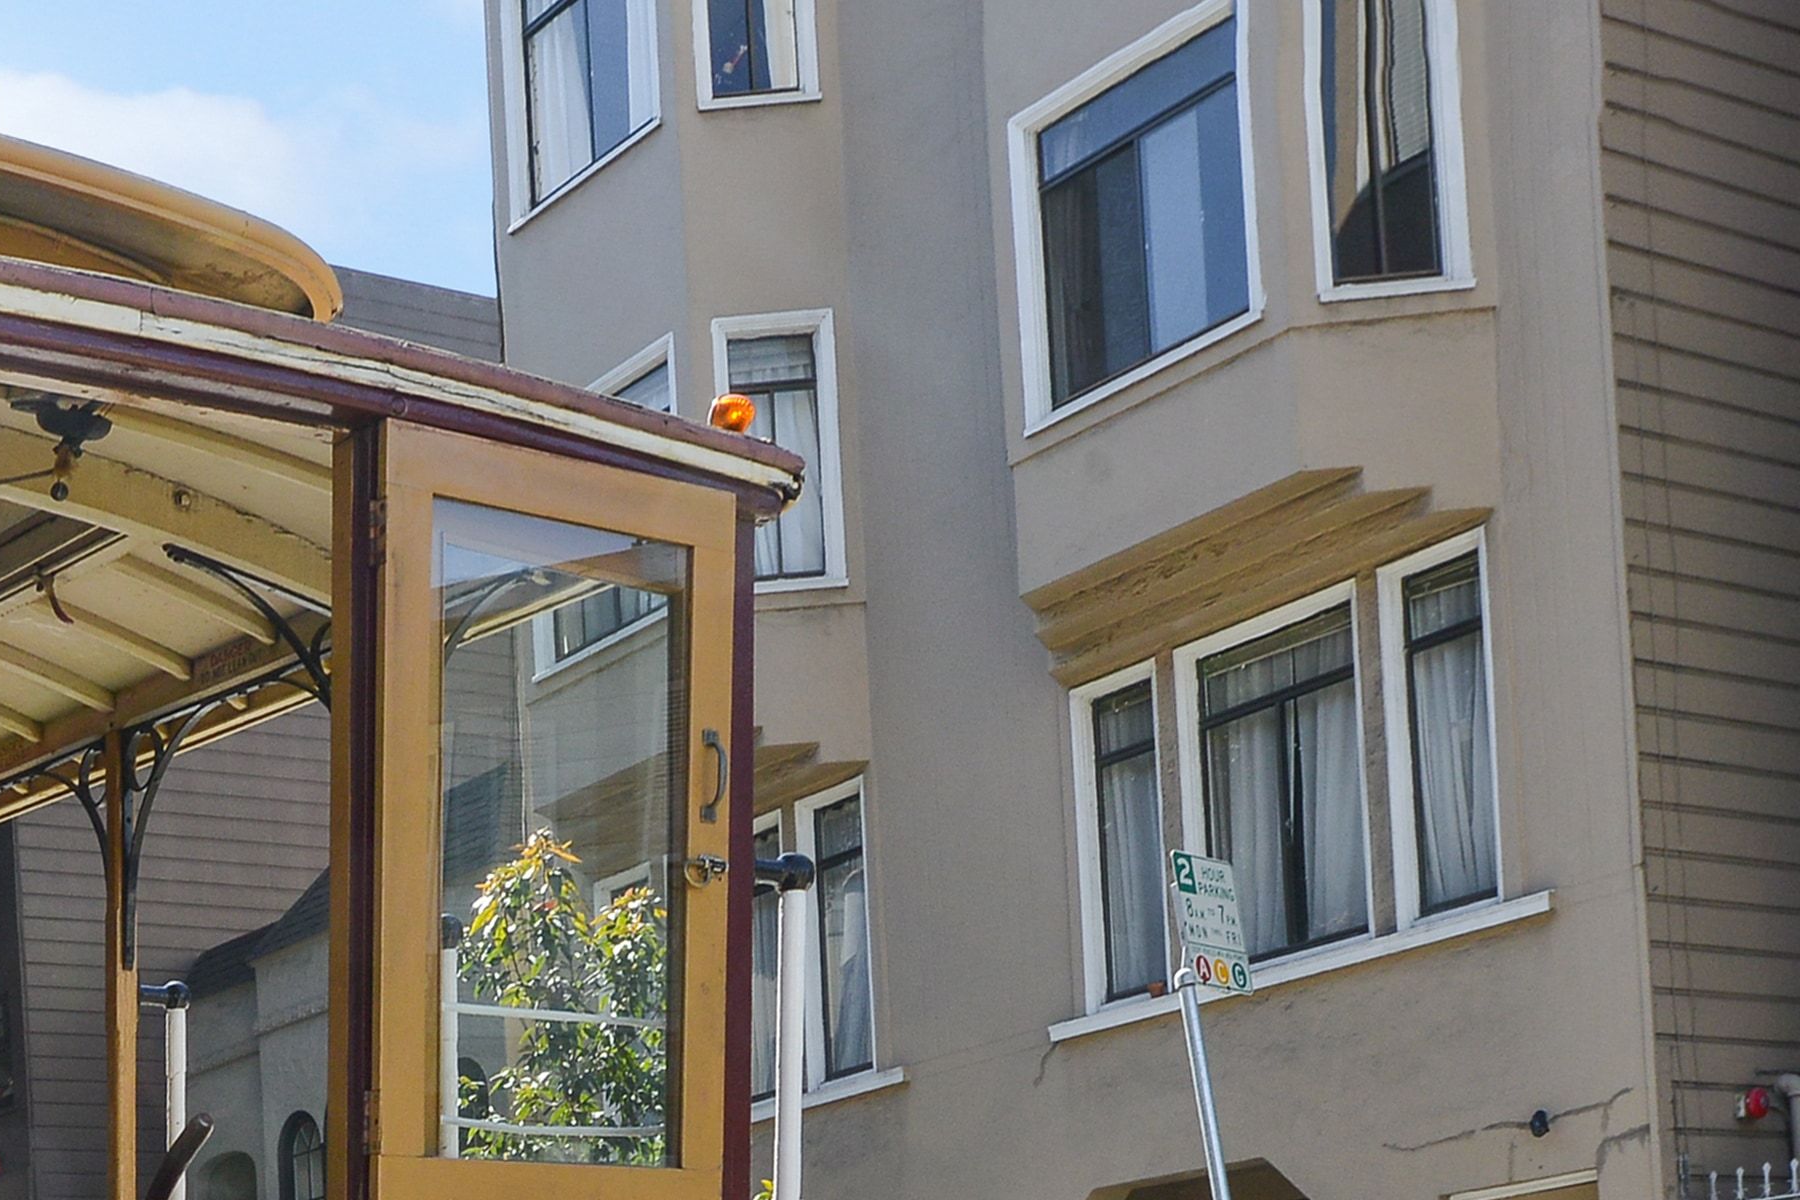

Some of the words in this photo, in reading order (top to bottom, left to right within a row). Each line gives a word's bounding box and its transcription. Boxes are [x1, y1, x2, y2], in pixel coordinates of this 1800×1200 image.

[1177, 858, 1193, 886] 2
[1201, 866, 1226, 883] HOUR
[1198, 881, 1236, 902] PARKING
